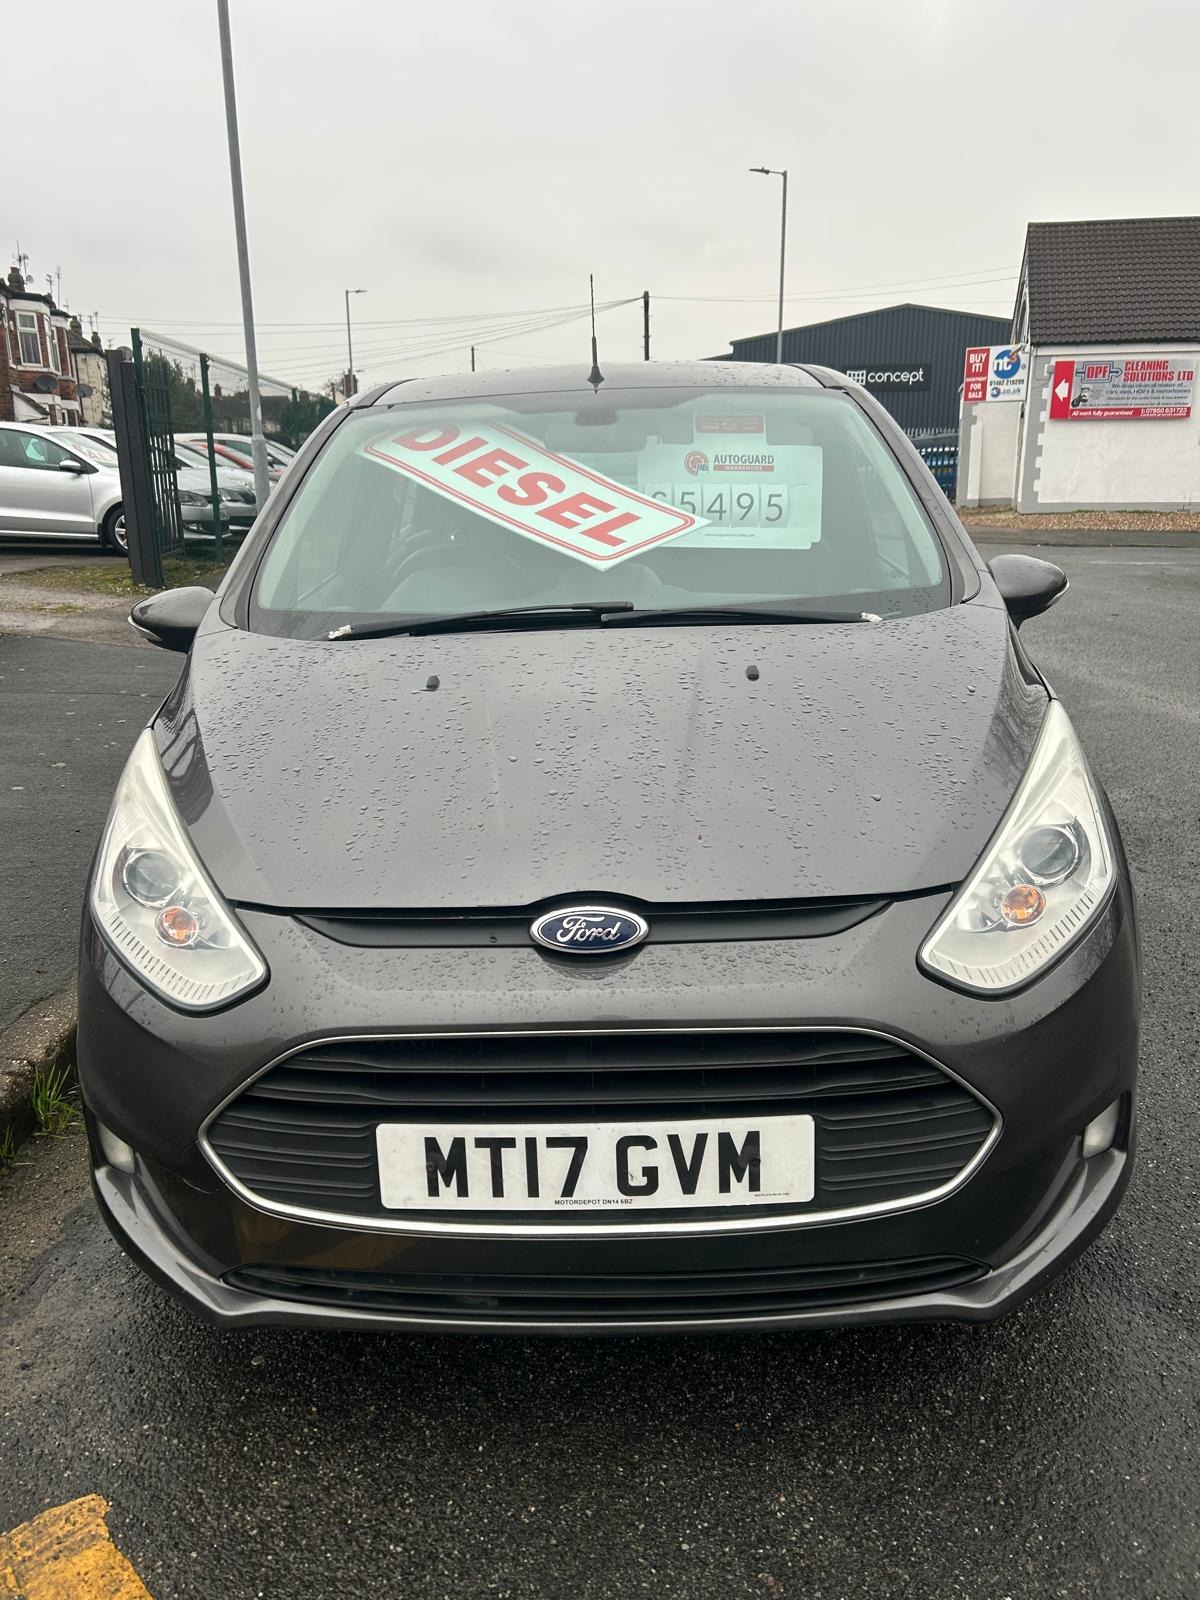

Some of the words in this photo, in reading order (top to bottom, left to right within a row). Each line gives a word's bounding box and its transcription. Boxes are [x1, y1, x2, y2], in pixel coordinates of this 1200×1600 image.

[969, 353, 987, 363] BUY
[971, 363, 983, 373] IT!
[1125, 360, 1169, 371] CLEANING
[867, 367, 924, 385] concept
[1086, 366, 1109, 379] DPF
[1123, 371, 1174, 382] SOLUTIONS
[1177, 371, 1193, 381] LTD
[713, 454, 774, 464] AUTOGUARD
[391, 422, 643, 548] DIESEL
[556, 915, 621, 942] Ford
[424, 1136, 588, 1198] MT17
[616, 1130, 760, 1197] GVM
